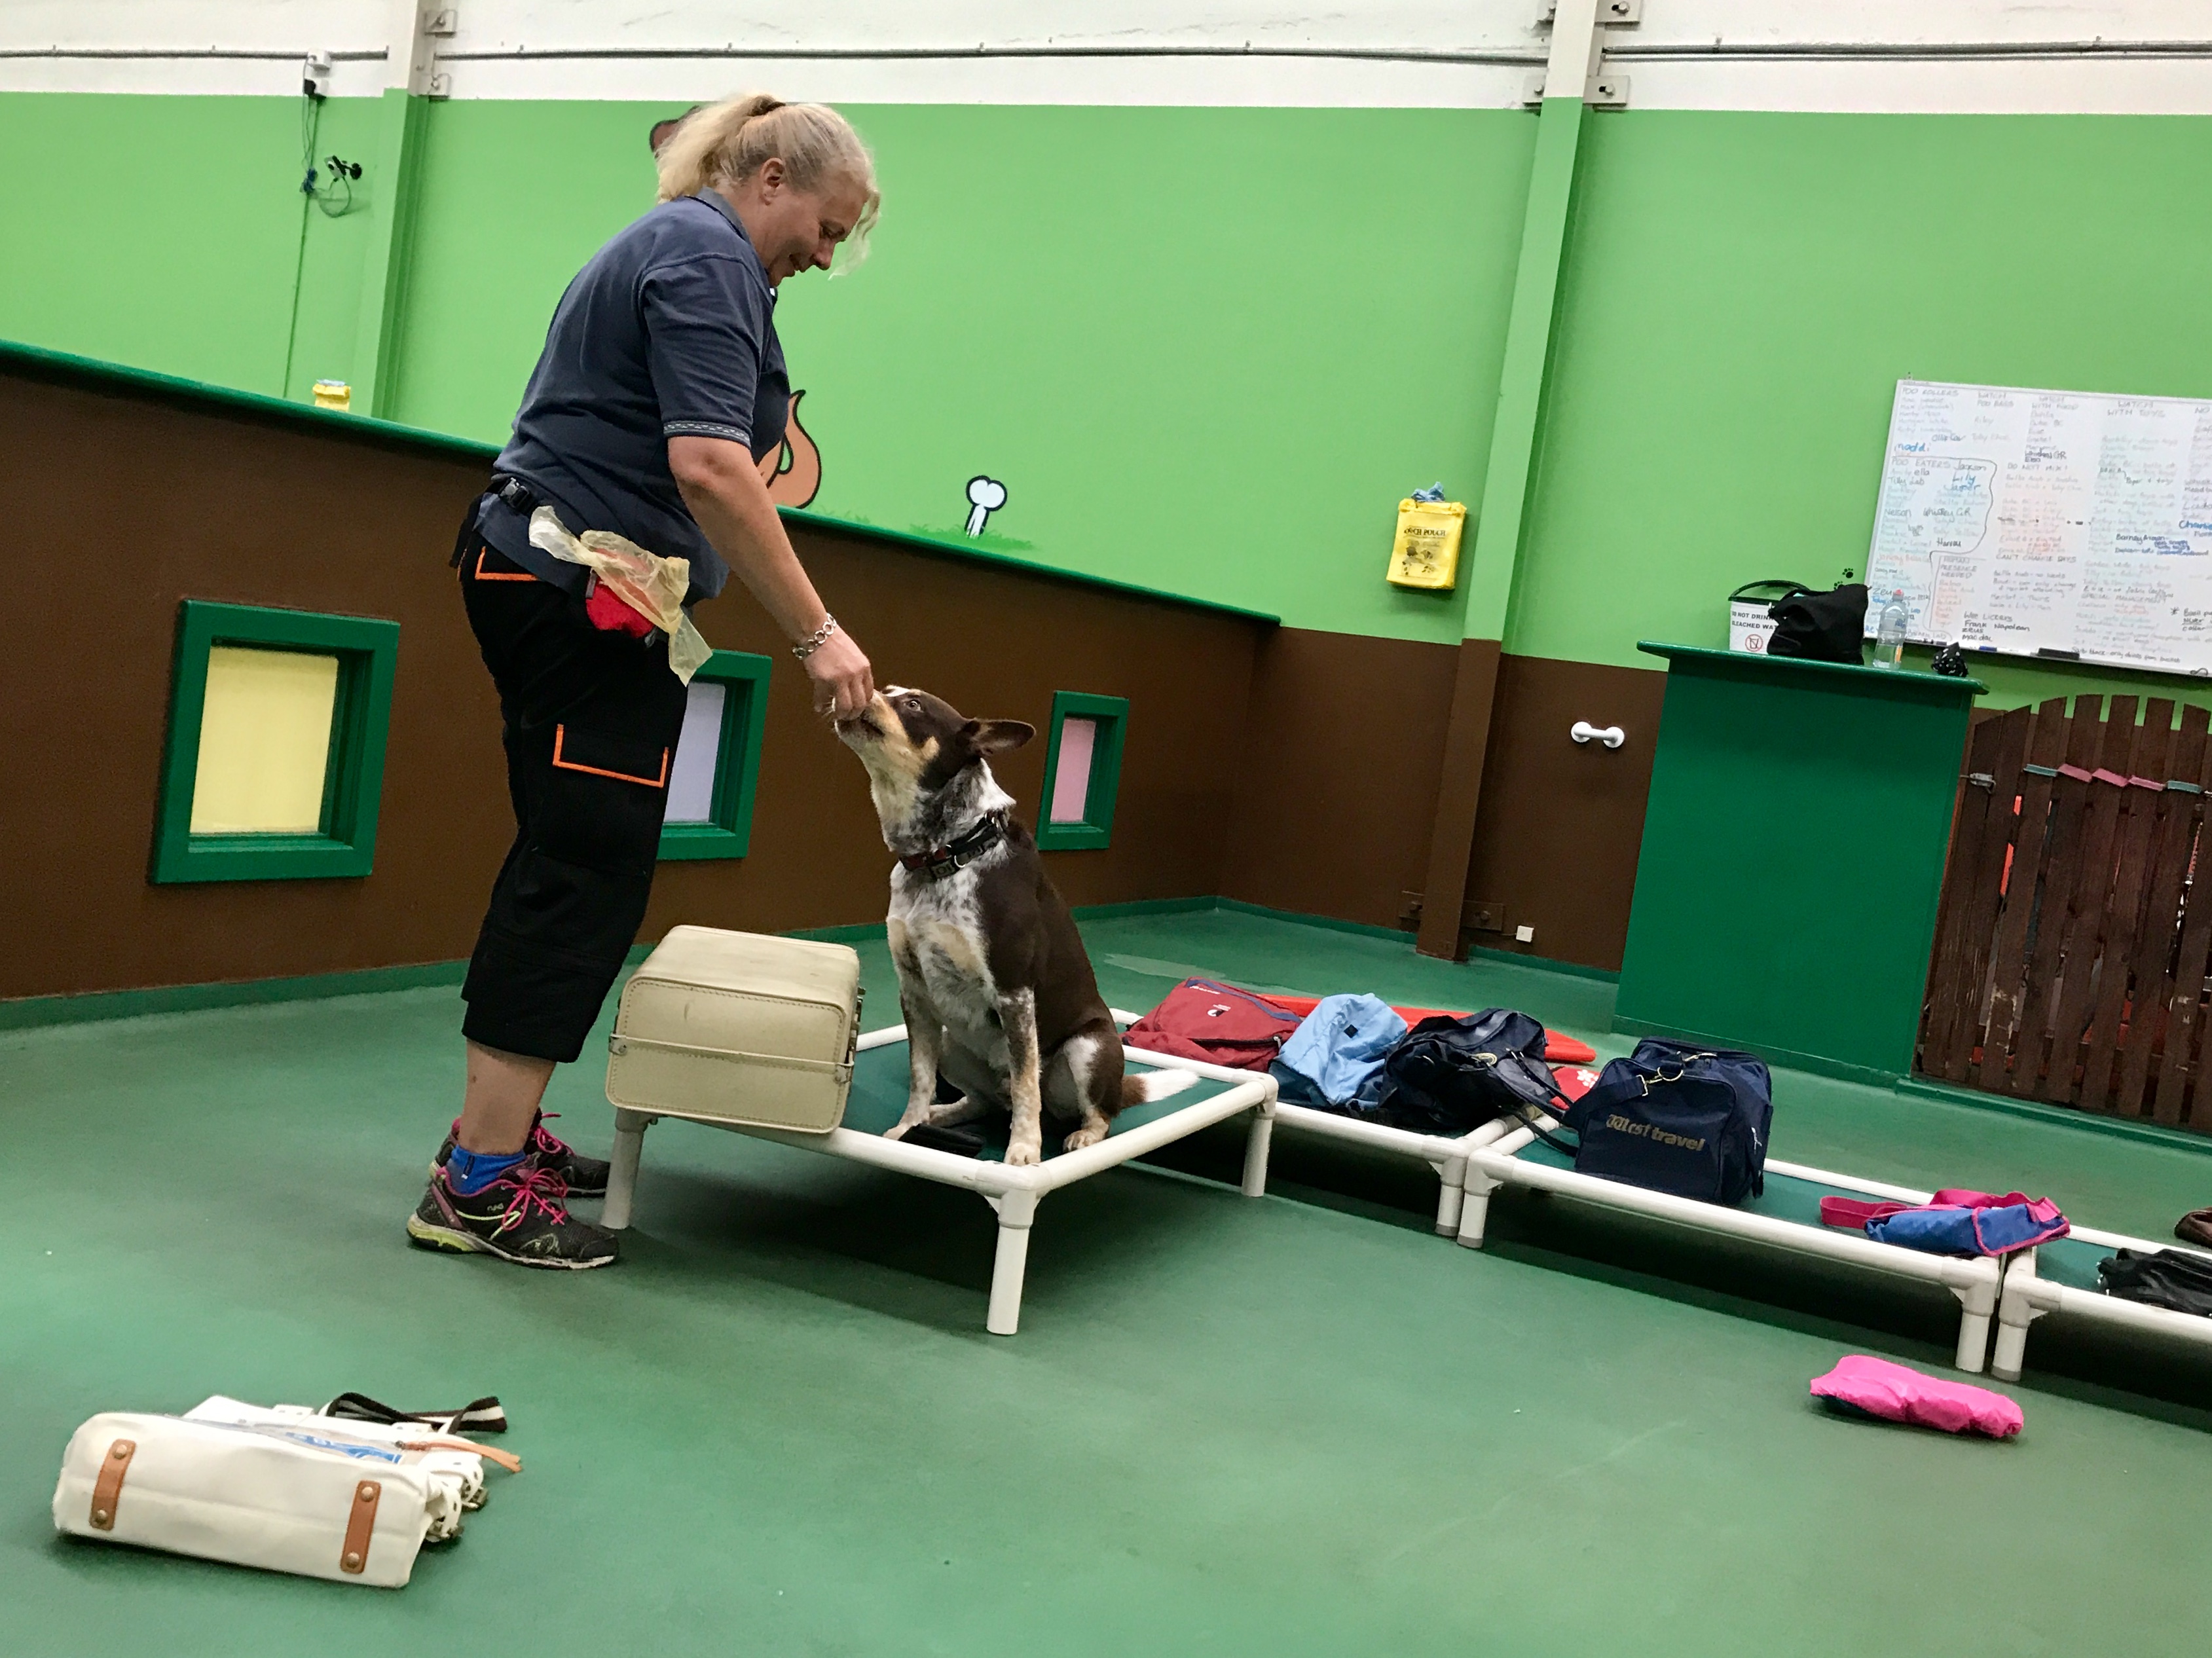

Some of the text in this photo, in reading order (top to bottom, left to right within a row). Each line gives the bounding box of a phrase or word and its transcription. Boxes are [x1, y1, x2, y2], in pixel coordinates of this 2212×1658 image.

[1915, 460, 1951, 470] EATERS
[1732, 620, 1760, 629] BLEACHED
[1964, 619, 1987, 629] Frank
[1651, 1126, 1706, 1151] travel
